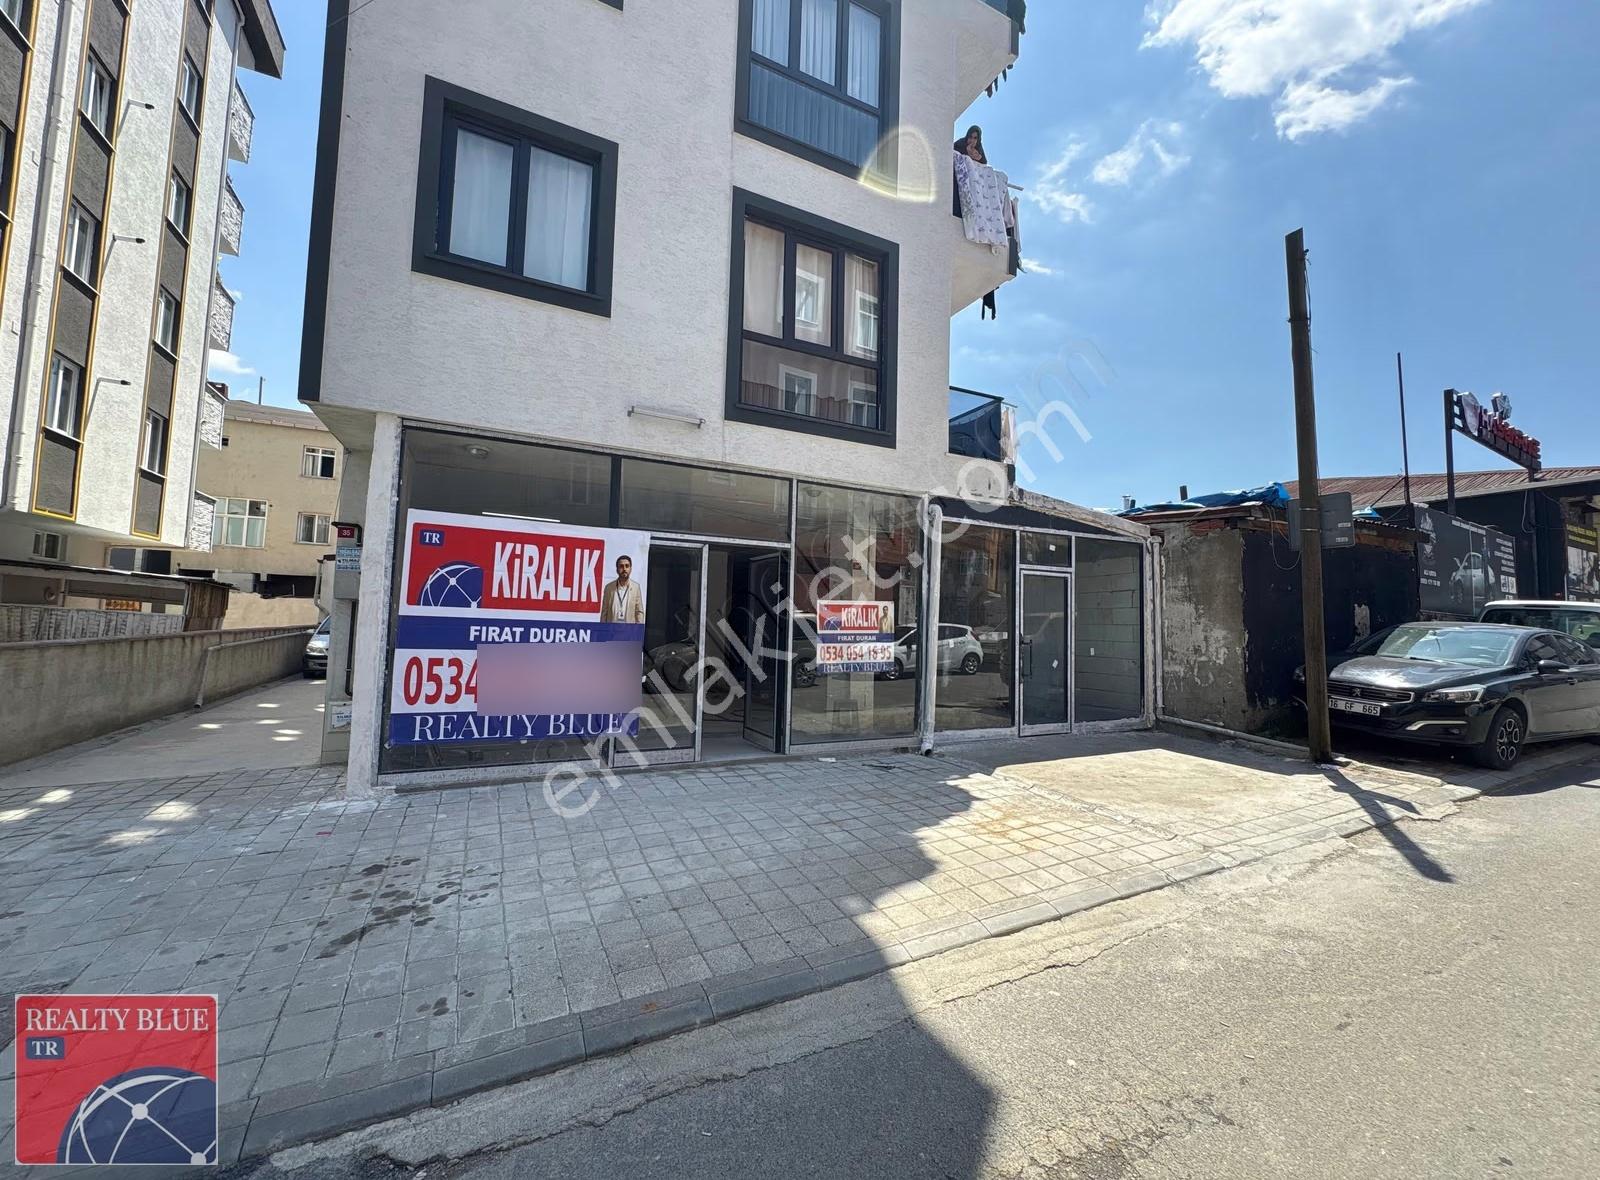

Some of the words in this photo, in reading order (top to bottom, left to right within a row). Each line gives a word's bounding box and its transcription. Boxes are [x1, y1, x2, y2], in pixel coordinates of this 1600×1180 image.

[423, 531, 441, 545] TR
[469, 625, 524, 642] FIRAT
[529, 628, 591, 643] DURAN
[820, 645, 844, 661] 0534
[823, 663, 862, 672] REALTY
[1329, 699, 1338, 708] 16
[1362, 704, 1378, 715] 665
[412, 714, 544, 741] REALTY
[549, 713, 622, 737] BLUE
